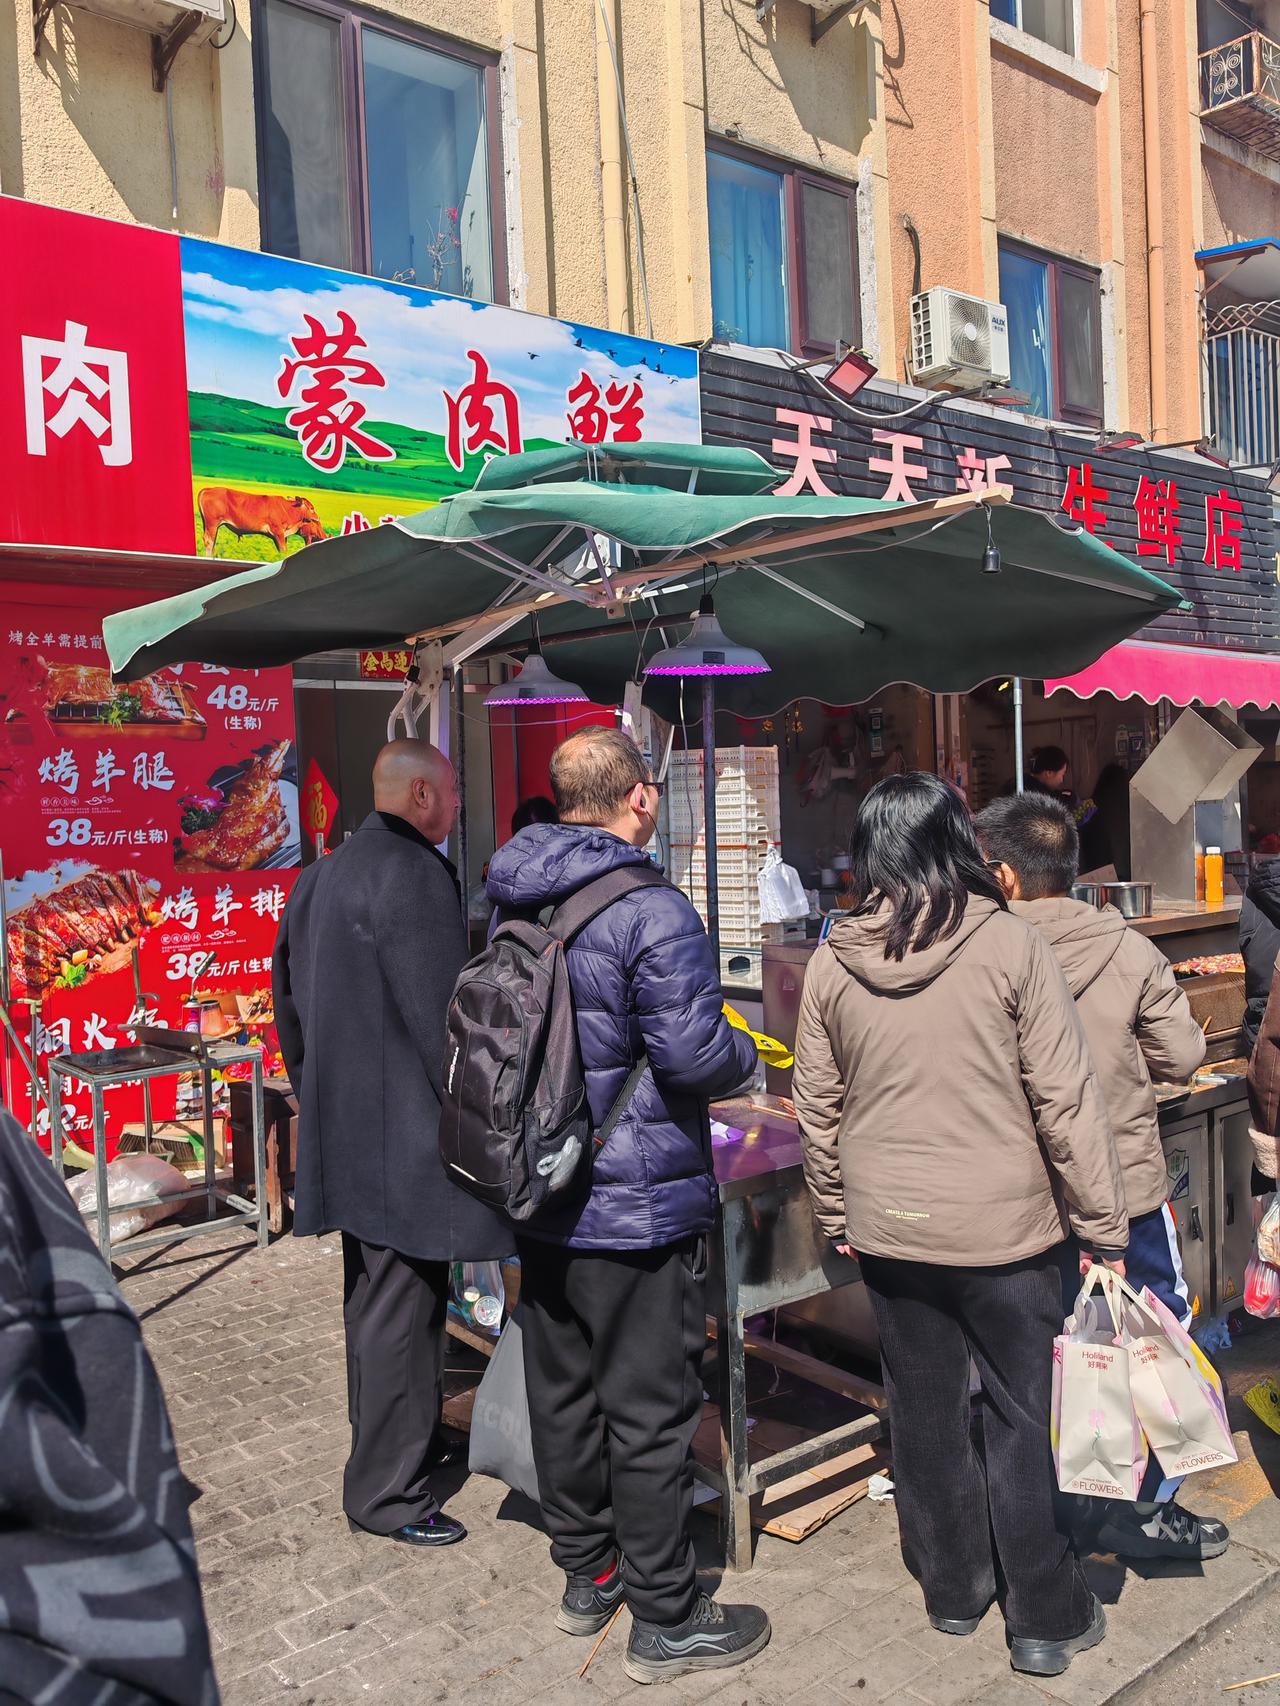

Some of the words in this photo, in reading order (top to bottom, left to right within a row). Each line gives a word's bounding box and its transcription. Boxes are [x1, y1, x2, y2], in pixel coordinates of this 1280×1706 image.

[21, 320, 133, 467] 肉
[207, 685, 279, 712] 48元/斤
[224, 716, 262, 730] (生称)
[38, 748, 176, 794] 烤羊腿
[160, 883, 286, 930] 烤羊排
[1181, 1452, 1224, 1470] FLOWERS
[1079, 1481, 1124, 1496] FLOWERS
